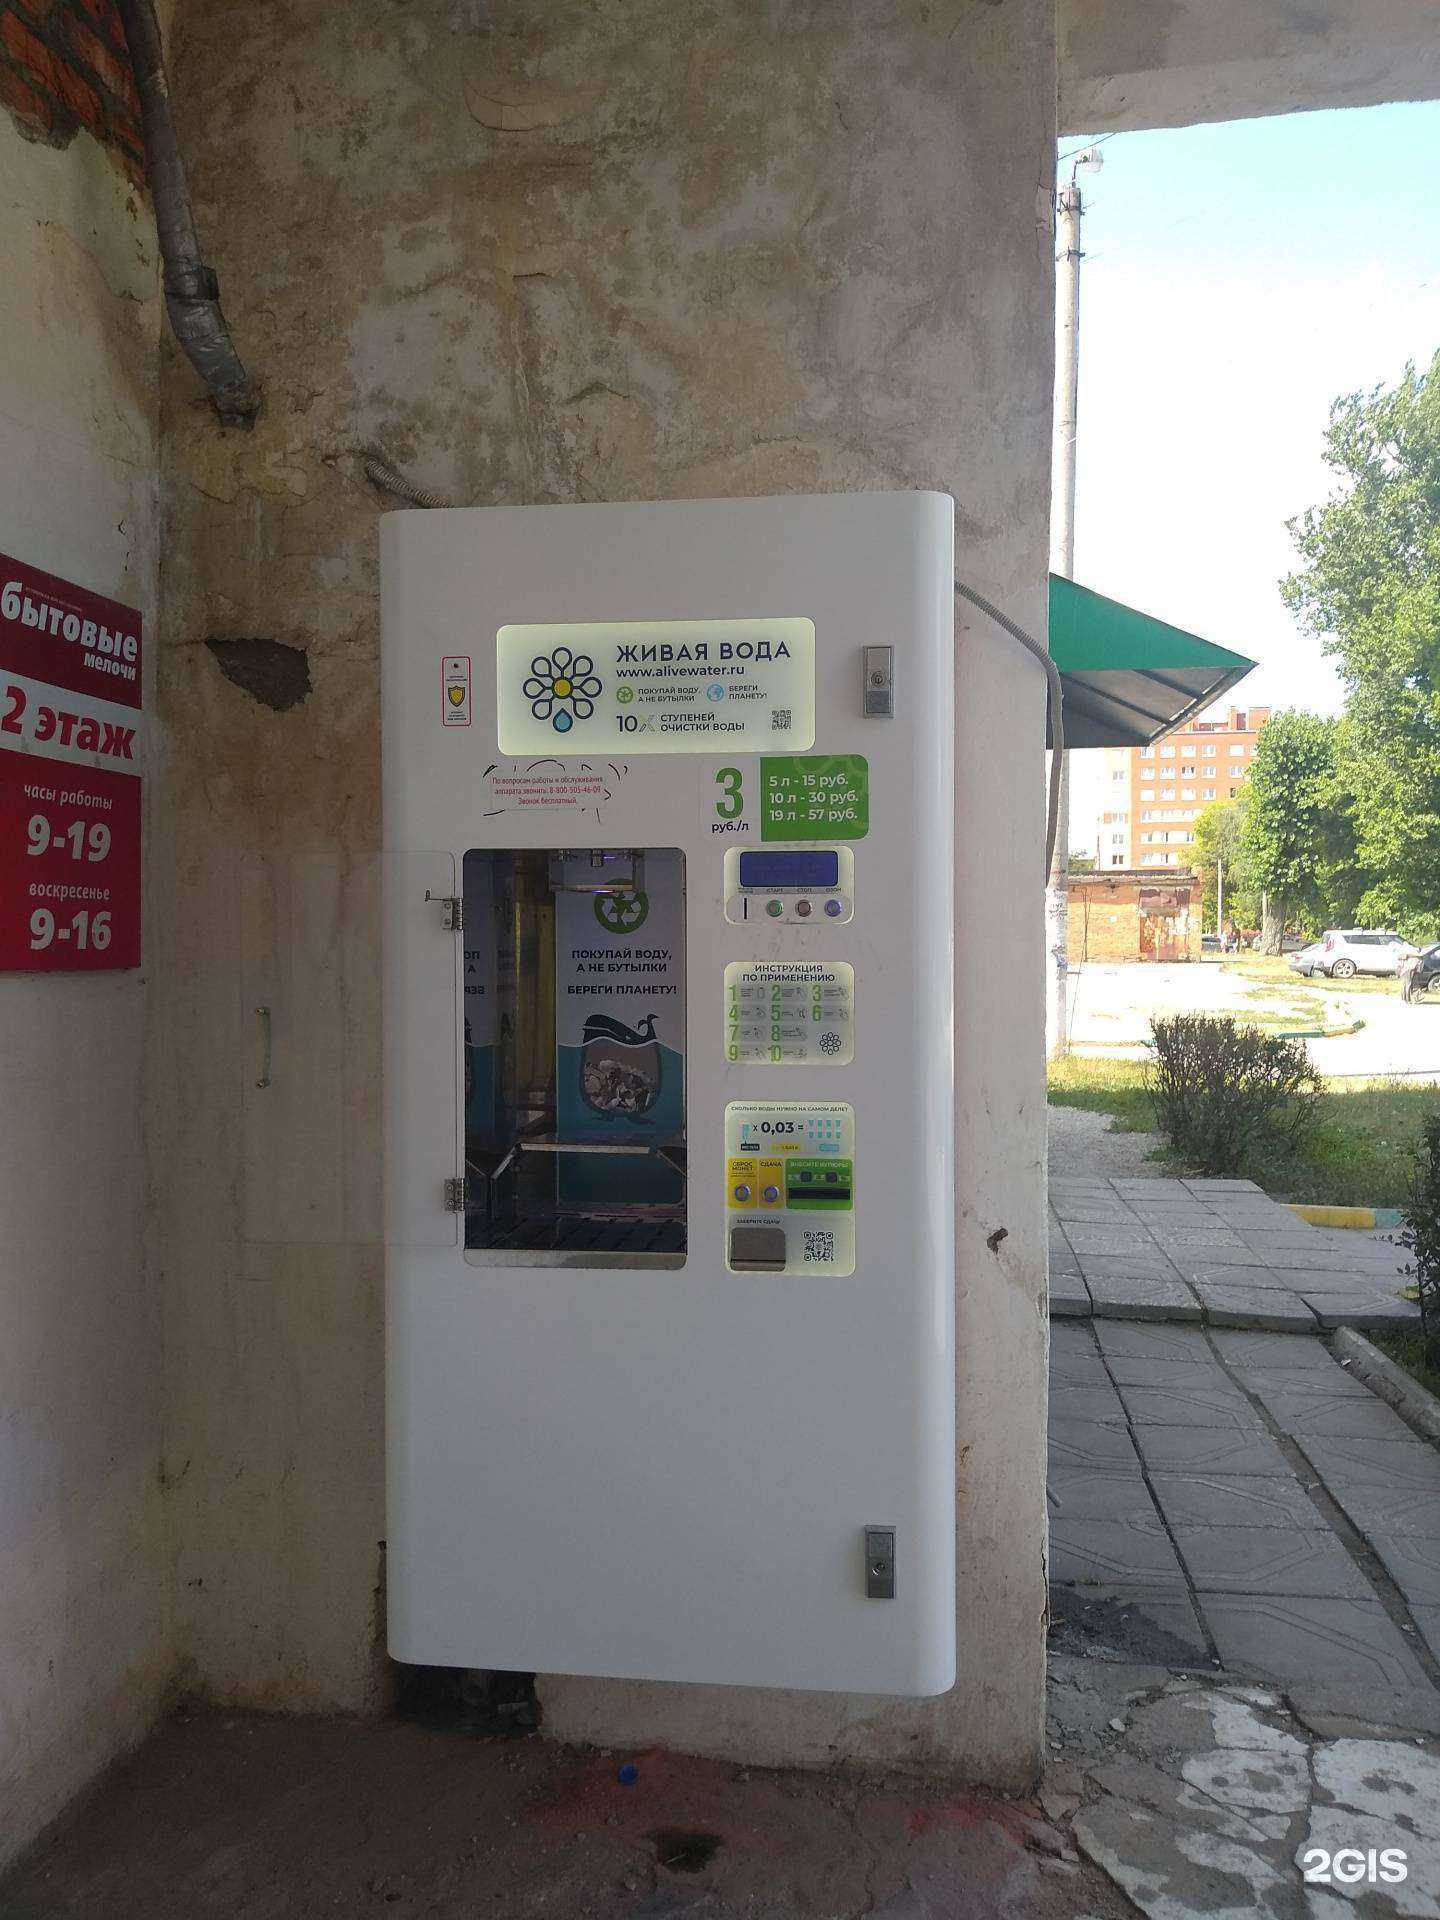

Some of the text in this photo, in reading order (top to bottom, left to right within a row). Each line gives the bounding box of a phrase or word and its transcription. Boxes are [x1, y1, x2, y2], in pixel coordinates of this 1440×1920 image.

[1, 582, 138, 661] бытовые
[616, 641, 791, 662] ЖИВАЯ ВОДА
[84, 652, 137, 681] мелочи
[616, 666, 745, 678] www.alivewater.ru
[638, 687, 676, 695] ПОКУПАЙ
[1, 684, 136, 760] 2 этаж
[660, 712, 715, 722] СТУПЕНЕЙ
[660, 722, 745, 732] ОЧИСТКИ ВОДЫ
[769, 776, 778, 786] 5
[781, 776, 790, 786] л
[802, 774, 816, 786] 15
[820, 773, 849, 788] руб.
[24, 784, 113, 810] часы работы
[716, 767, 744, 819] 3
[770, 792, 784, 804] 10
[786, 794, 796, 803] л
[808, 792, 826, 803] 30
[830, 790, 859, 805] руб.
[770, 810, 784, 821] 19
[786, 811, 796, 820] л
[808, 809, 824, 820] 57
[829, 808, 858, 822] руб.
[712, 820, 749, 834] руб./л
[27, 814, 111, 862] 9-19
[29, 881, 110, 900] воскресенье
[30, 907, 112, 950] 9-16
[572, 948, 672, 961] ПОКУПАЙ ВОДУ,
[576, 962, 667, 972] А НЕ БУТЫЛКИ
[754, 964, 823, 973] ИНСТРУКЦИЯ
[742, 974, 835, 982] ПО ПРИМЕНЕНИЮ
[568, 985, 677, 996] БЕРЕГИ ПЛАНЕТУ!
[729, 984, 736, 1001] 1
[772, 984, 780, 1001] 2
[812, 984, 821, 1001] 3
[729, 1005, 738, 1021] 4
[771, 1004, 780, 1021] 5
[812, 1004, 821, 1021] 6
[729, 1024, 738, 1041] 7
[771, 1024, 780, 1041] 8
[729, 1044, 738, 1061] 9
[768, 1045, 781, 1062] 10
[760, 1122, 794, 1135] 0,03
